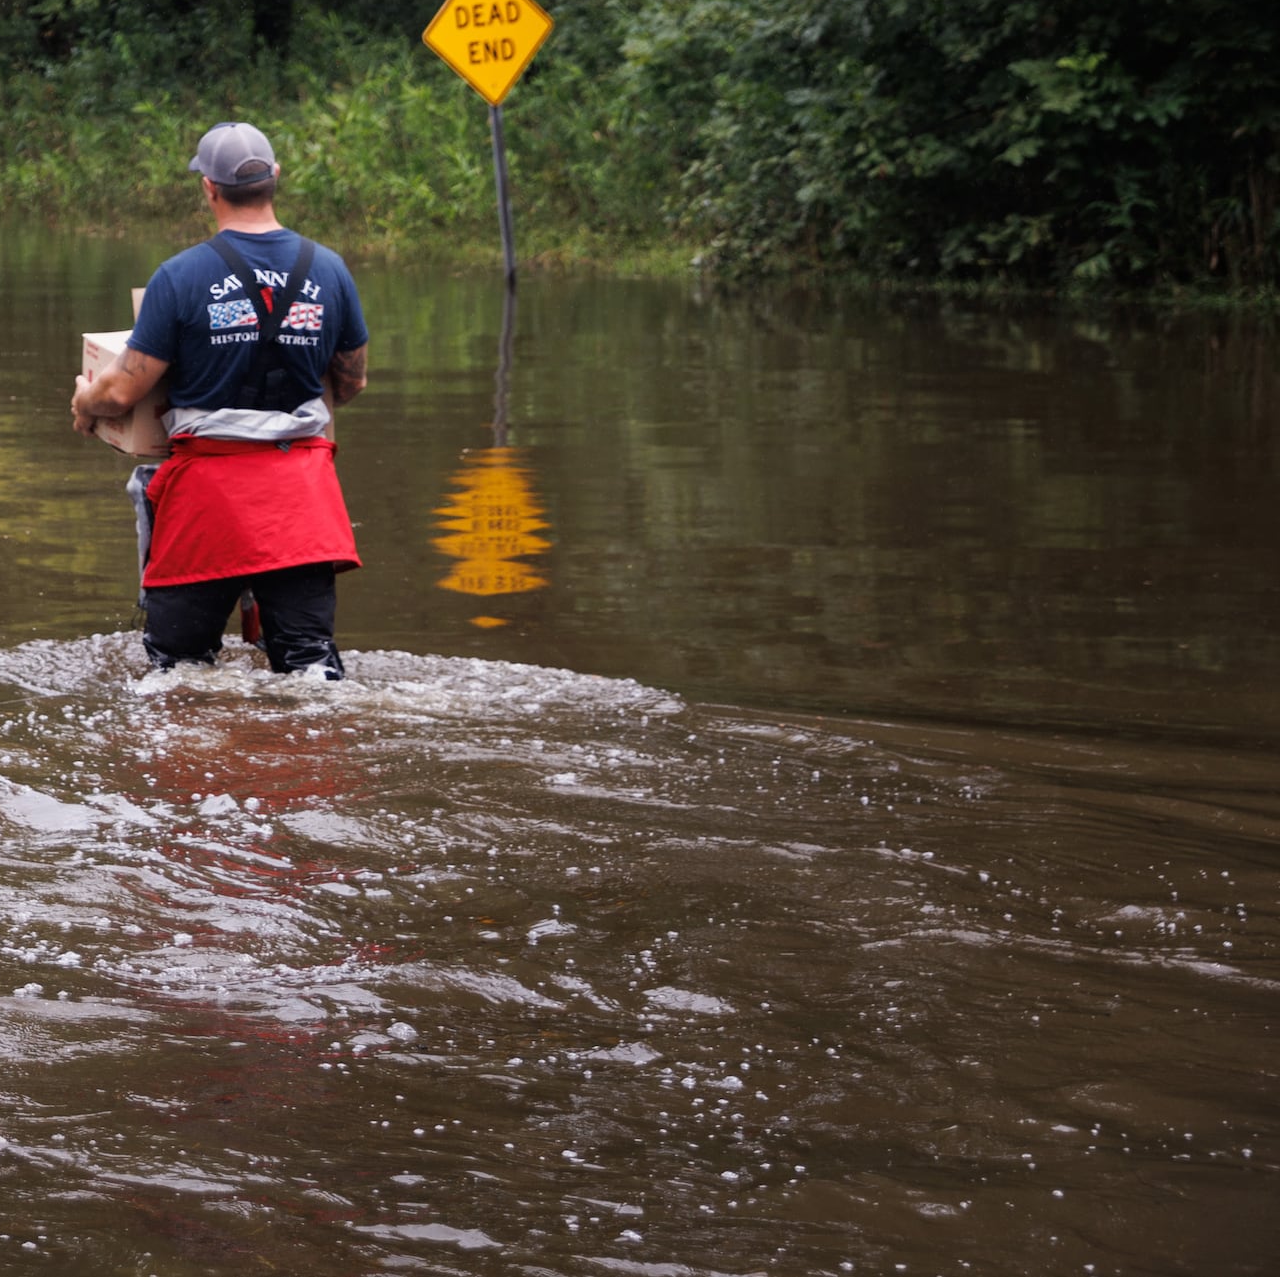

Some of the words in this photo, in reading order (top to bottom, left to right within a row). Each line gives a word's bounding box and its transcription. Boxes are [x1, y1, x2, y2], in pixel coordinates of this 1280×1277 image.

[454, 0, 521, 29] DEAD
[467, 37, 516, 65] END
[210, 268, 321, 301] SAVNNH
[278, 334, 320, 347] STRICT
